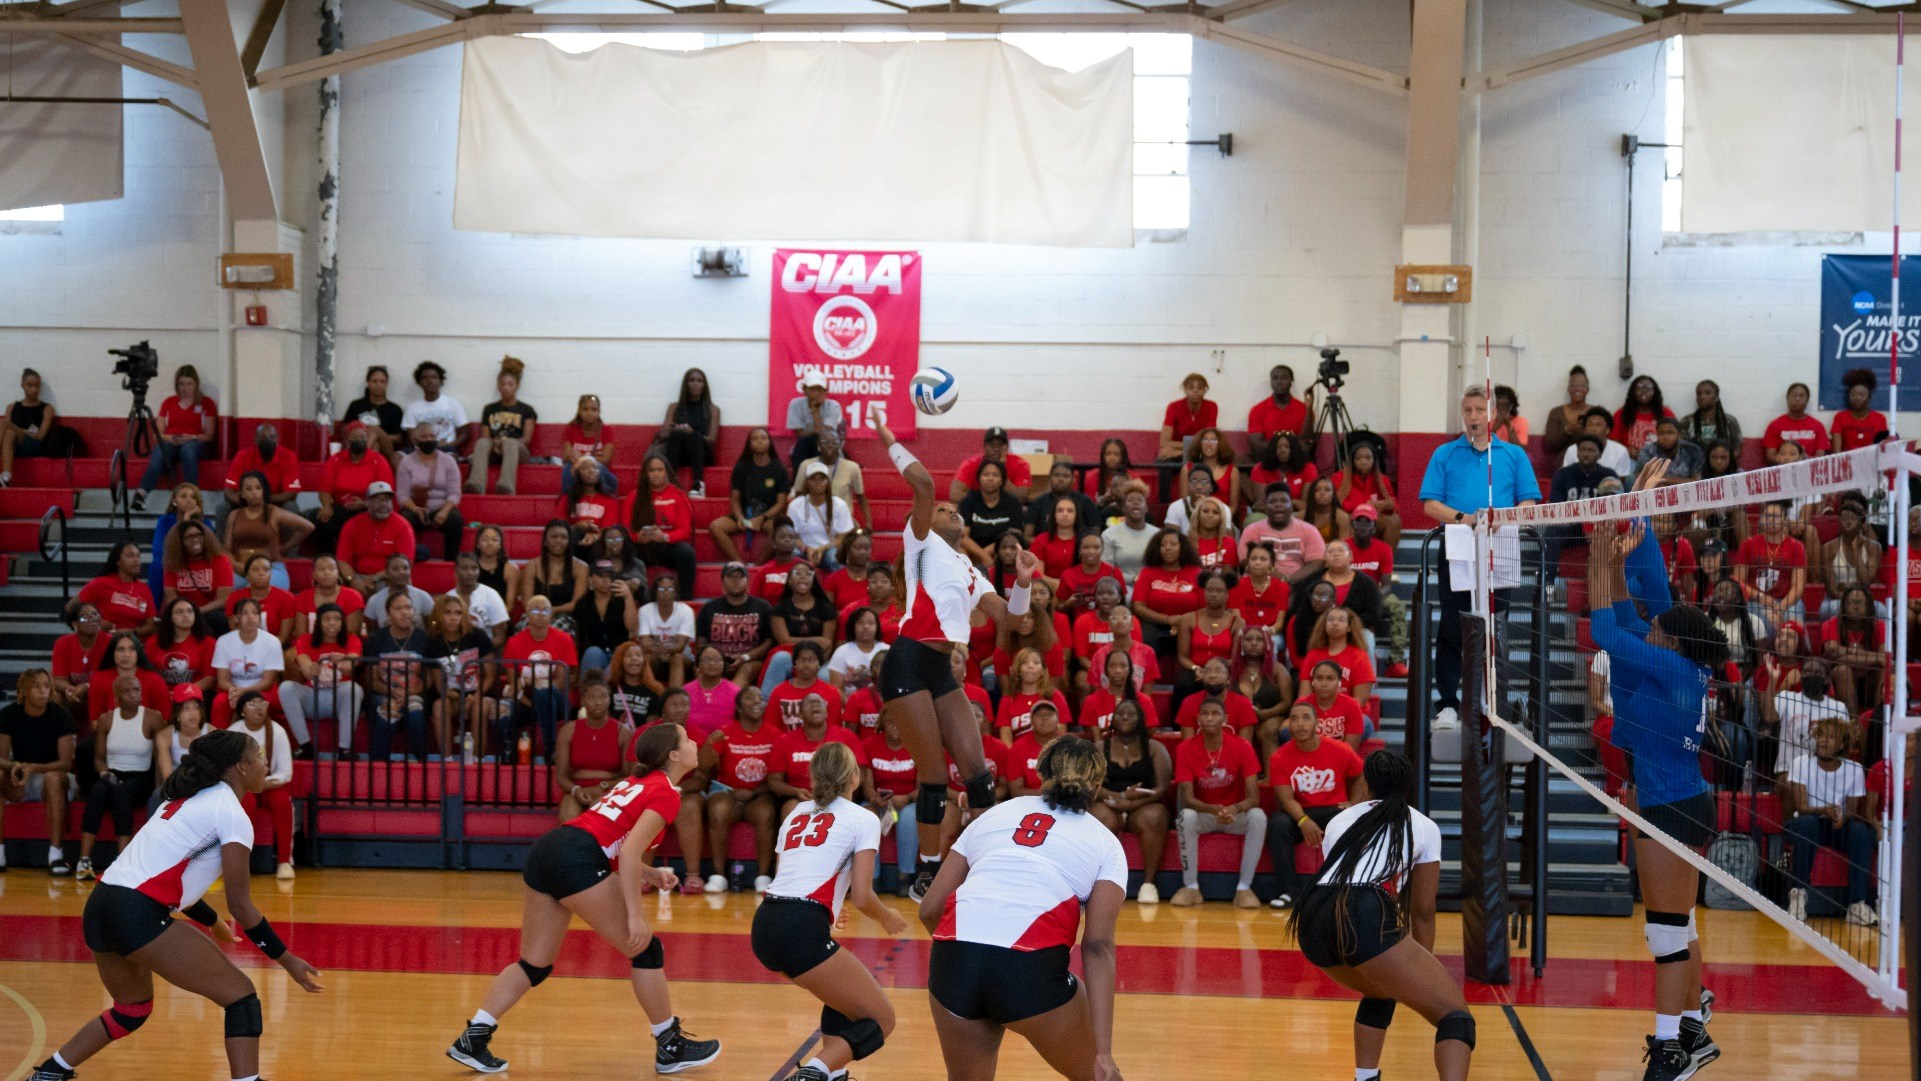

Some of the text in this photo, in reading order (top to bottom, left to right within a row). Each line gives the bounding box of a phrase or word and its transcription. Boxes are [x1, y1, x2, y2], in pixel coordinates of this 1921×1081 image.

[781, 252, 903, 295] CIAA
[823, 316, 866, 332] CIAA
[1908, 315, 1921, 328] IT
[796, 379, 892, 395] CMPIONS
[711, 623, 759, 642] BLACK
[1293, 768, 1336, 793] 1892
[783, 812, 836, 851] 23
[1011, 812, 1057, 848] 8
